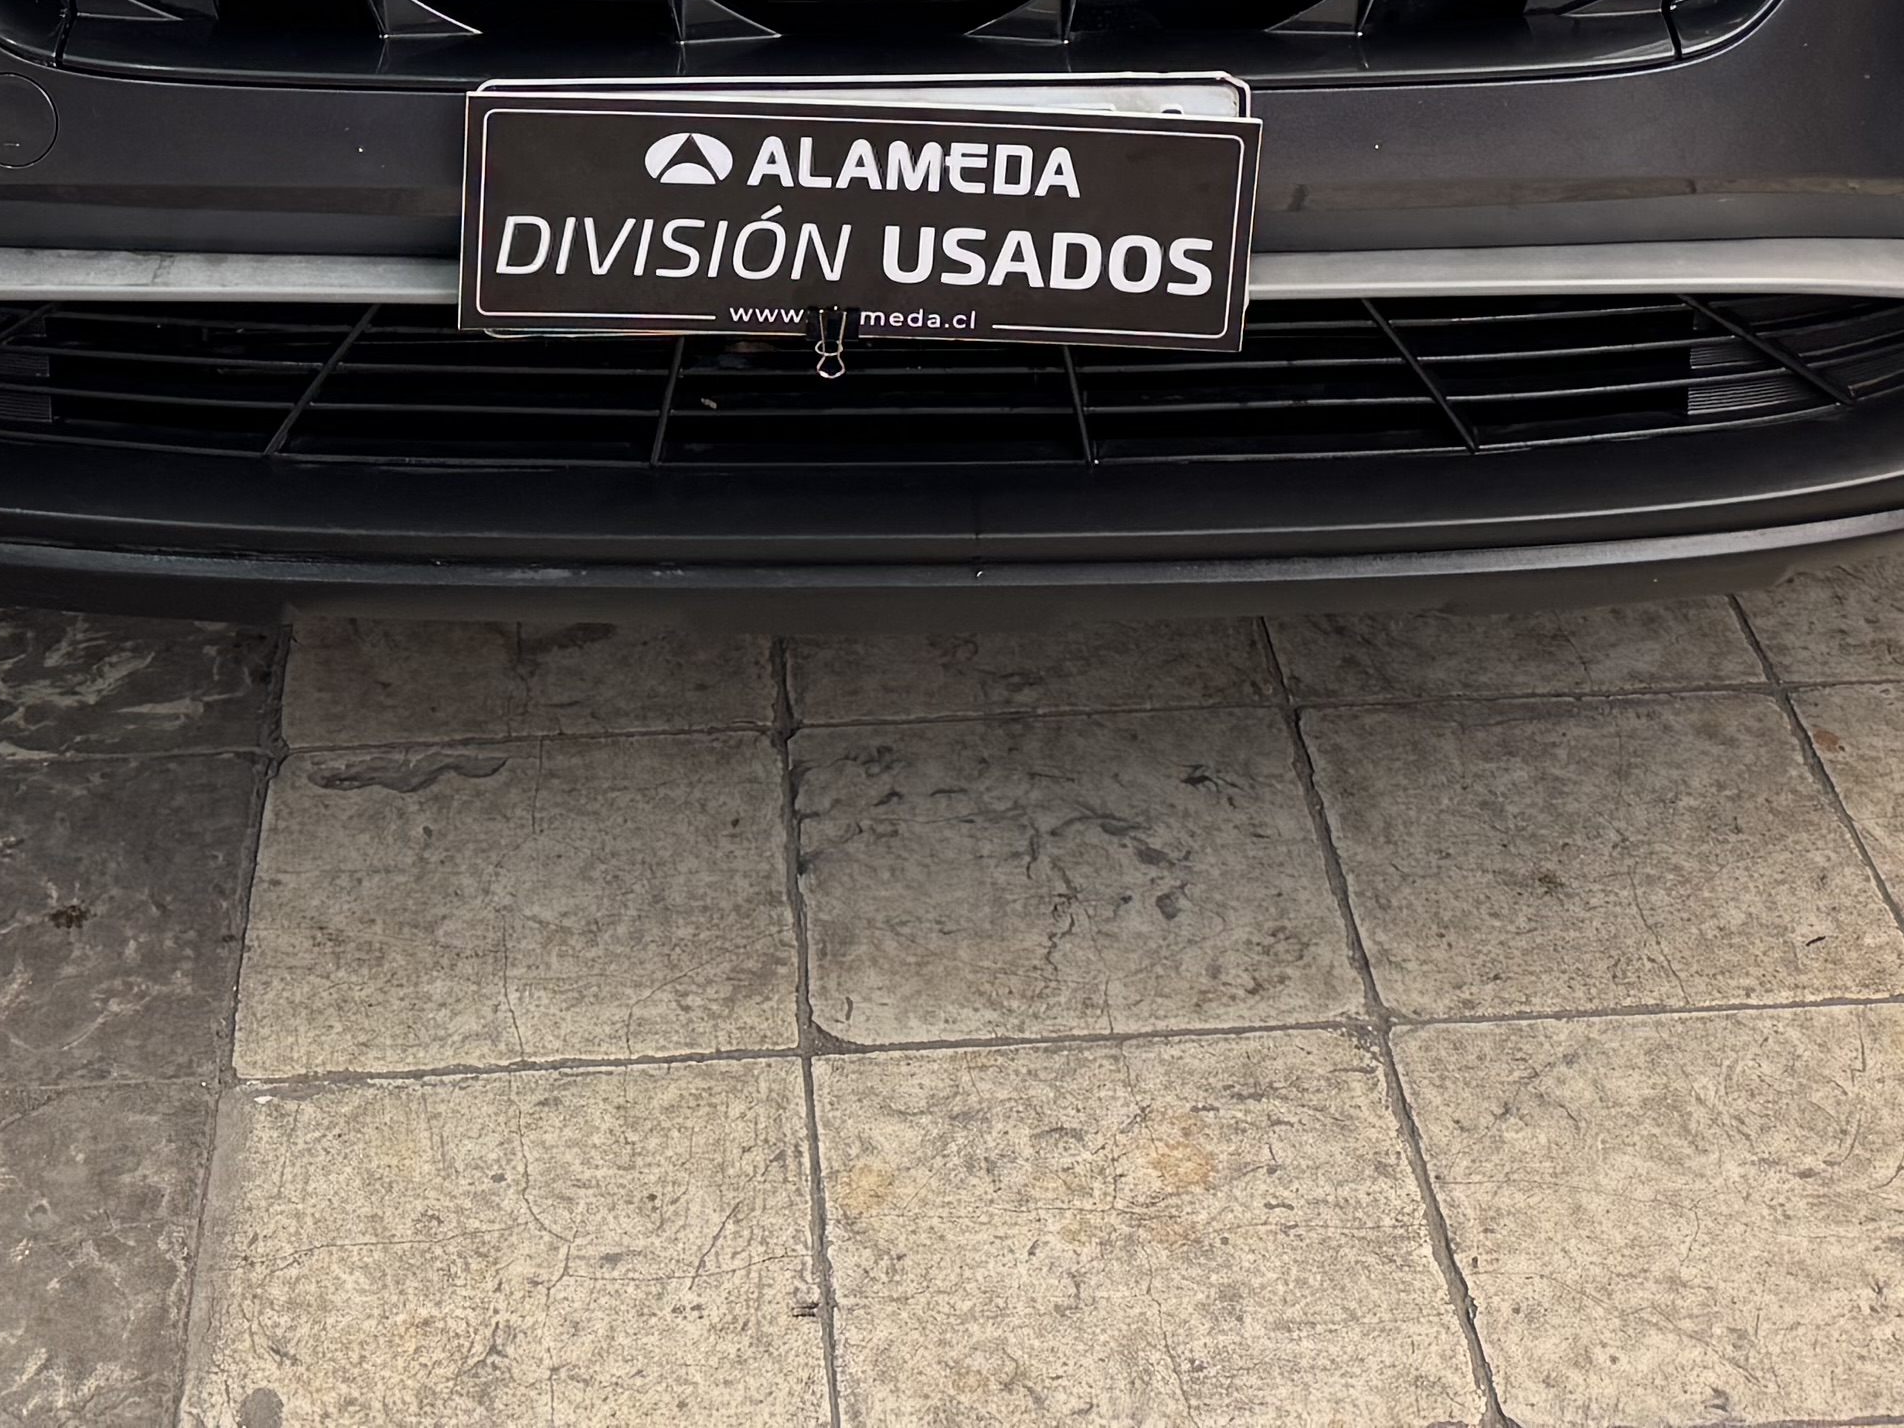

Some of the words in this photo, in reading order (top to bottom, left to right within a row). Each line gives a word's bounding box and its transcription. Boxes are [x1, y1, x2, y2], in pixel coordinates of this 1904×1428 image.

[746, 134, 1081, 199] ALAMEDA
[495, 204, 852, 281] DIVISIÓN
[882, 225, 1213, 296] USADOS
